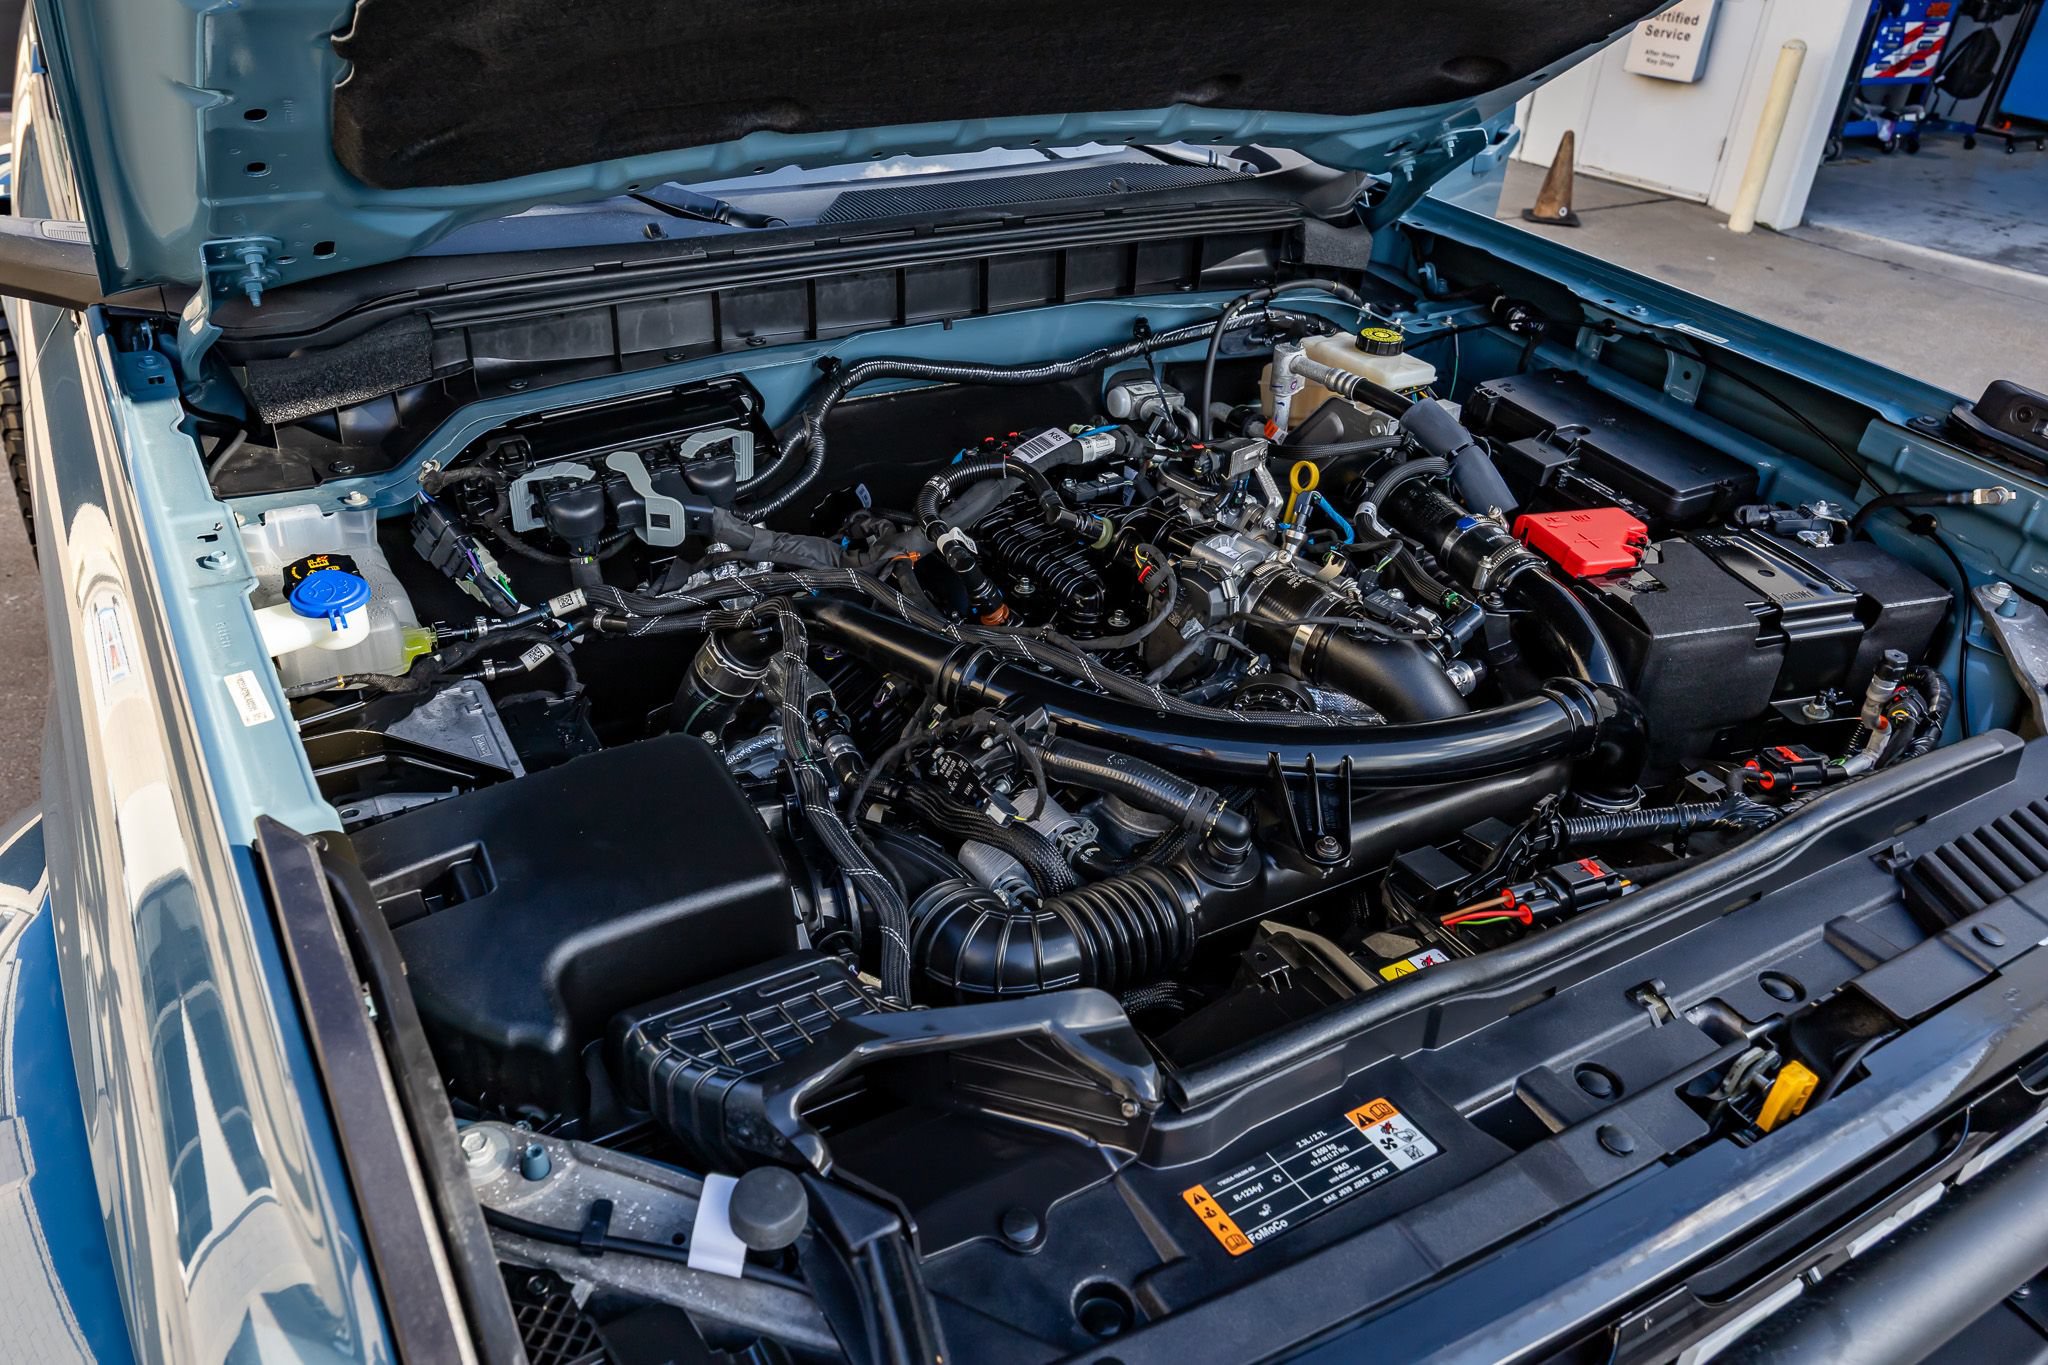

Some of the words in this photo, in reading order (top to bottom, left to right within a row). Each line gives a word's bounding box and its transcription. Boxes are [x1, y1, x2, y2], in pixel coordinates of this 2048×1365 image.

[1655, 12, 1699, 26] ertified
[1645, 24, 1691, 41] Service
[1047, 431, 1065, 442] K85
[1296, 1137, 1312, 1149] 2.3L
[1312, 1129, 1328, 1141] 2.7L
[1332, 1161, 1350, 1174] PAG
[1232, 1182, 1265, 1203] R-1234yf
[1248, 1218, 1289, 1244] FoMoCo
